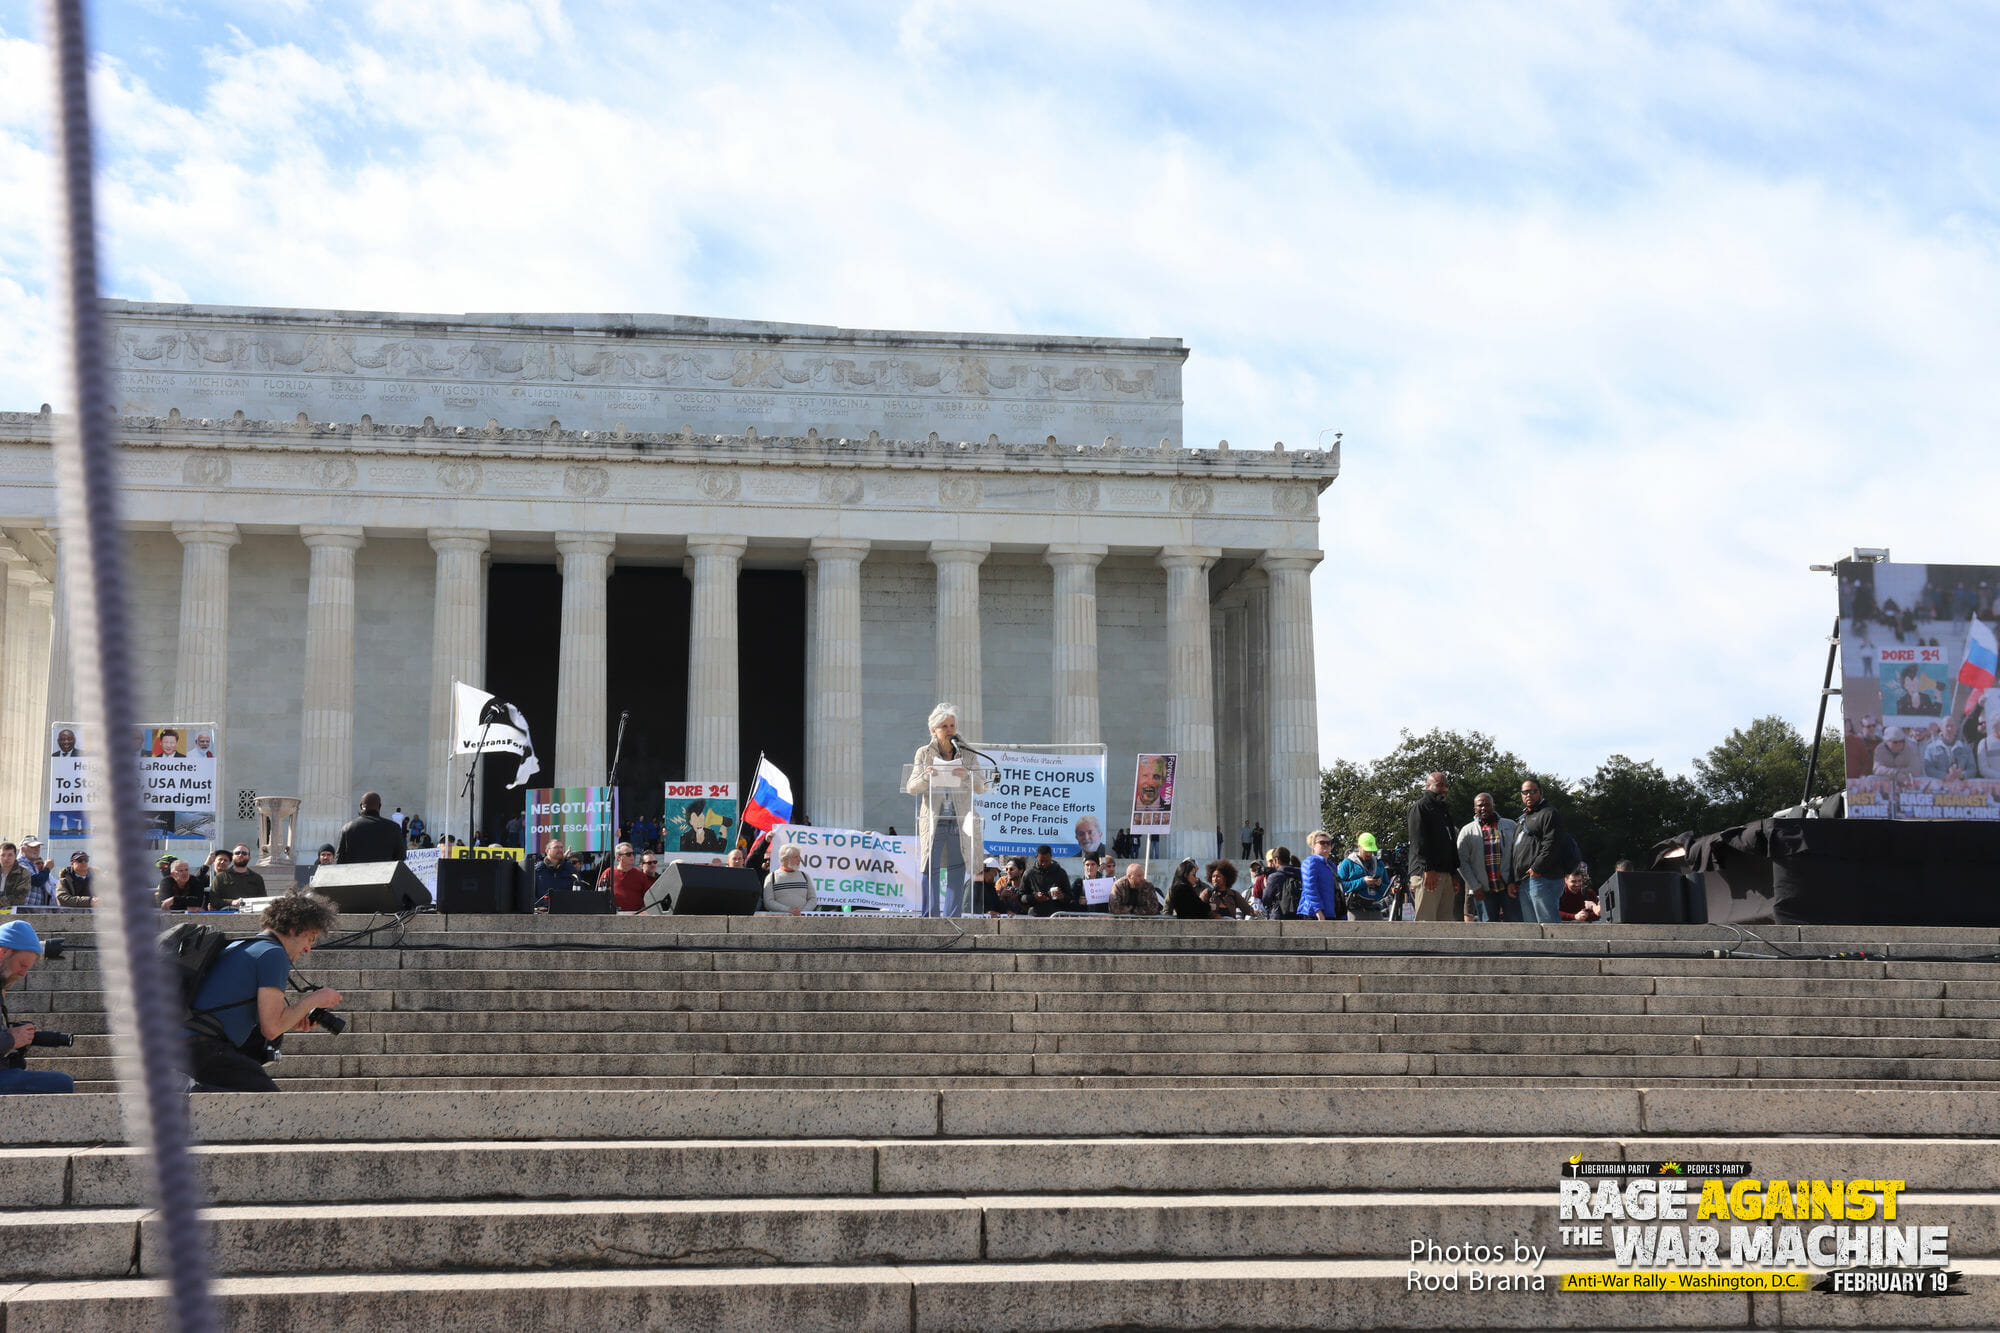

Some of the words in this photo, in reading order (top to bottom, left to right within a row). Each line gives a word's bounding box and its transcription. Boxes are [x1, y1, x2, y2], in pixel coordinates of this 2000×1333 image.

[188, 376, 250, 388] MICHIGAN
[263, 379, 313, 391] FLORIDA
[330, 381, 366, 393] TEXAS
[383, 383, 417, 395] IOWA
[431, 384, 499, 397] WISCONSIN
[511, 387, 581, 400] CALIFORNIA
[594, 391, 661, 403] MINNESOTA
[673, 393, 721, 404] OREGON
[733, 395, 776, 407] KANSAS
[787, 397, 816, 409] WEST
[819, 397, 871, 409] VIRGINIA
[882, 399, 925, 410] NEVADA
[935, 401, 992, 412] NEBRASKA
[1003, 403, 1066, 415] COLORADO
[1075, 405, 1114, 417] NORTH
[1881, 649, 1915, 661] DORE
[1920, 649, 1940, 661] 24
[1001, 753, 1019, 762] Dona
[1020, 756, 1039, 764] Nobis
[1003, 768, 1031, 780] THE
[1034, 771, 1095, 783] CHORUS
[1165, 756, 1175, 784] Forever
[55, 778, 71, 788] To
[148, 778, 176, 789] USA
[180, 779, 212, 790] Must
[668, 785, 703, 797] DORE
[708, 784, 729, 797] 24
[1024, 785, 1070, 798] PEACE
[1163, 786, 1172, 805] WAR
[55, 793, 83, 804] Join
[143, 793, 211, 807] Paradigm!
[1900, 793, 1934, 805] RAGE
[1935, 794, 1987, 807] AGAINST
[530, 801, 612, 815] NEGOTIATE
[1011, 800, 1027, 810] the
[1029, 802, 1060, 812] Peace
[1062, 803, 1096, 813] Efforts
[1913, 806, 1942, 818] WAR
[1943, 807, 2000, 819] MACHINE
[991, 813, 1002, 822] of
[1003, 813, 1030, 824] Pope
[1032, 816, 1069, 826] Francis
[531, 824, 560, 834] DON'T
[1000, 825, 1008, 835] &
[1010, 825, 1036, 836] Pres.
[1038, 827, 1059, 837] Lula
[786, 830, 818, 845] YES
[822, 833, 847, 847] TO
[851, 836, 907, 855] PEACE.
[989, 843, 1026, 853] SCHILLER
[1028, 845, 1068, 854] INUTE
[458, 849, 517, 861] BIDEN
[799, 854, 822, 869] NO
[826, 856, 851, 870] TO
[855, 858, 899, 874] WAR.
[813, 878, 835, 892] TE
[839, 879, 904, 897] GREEN!
